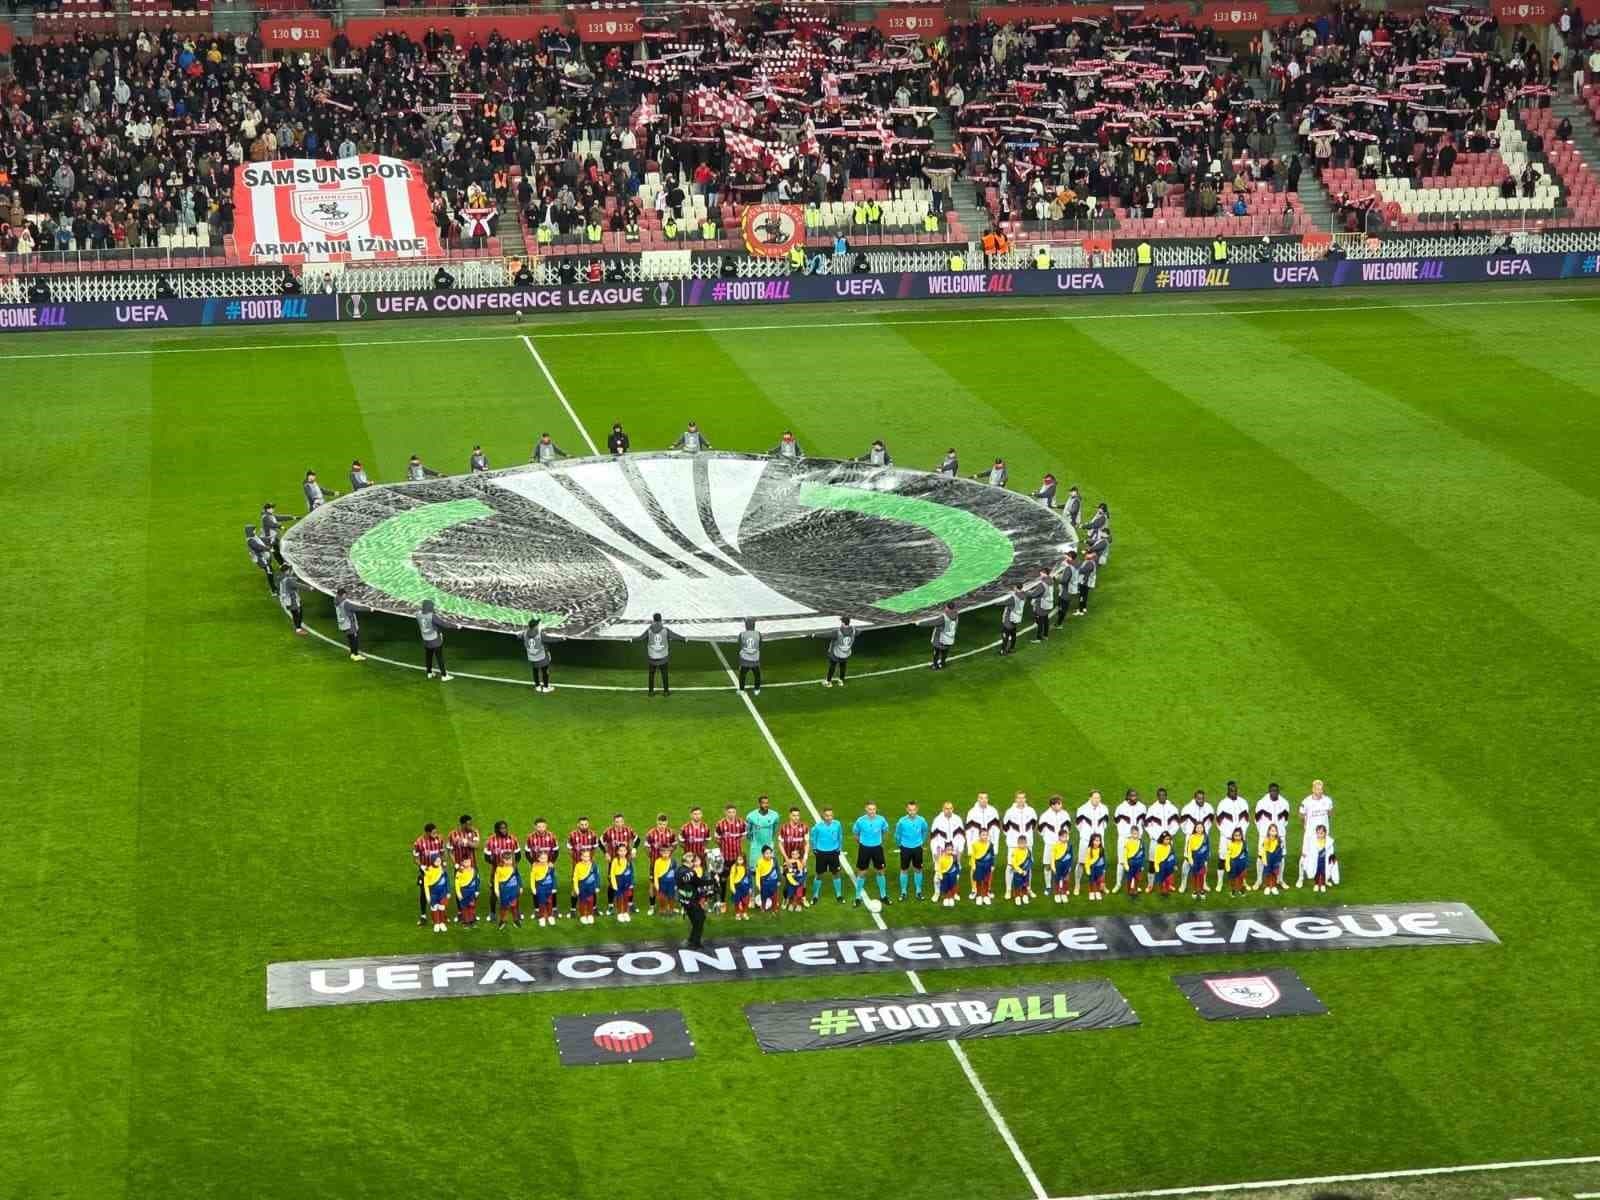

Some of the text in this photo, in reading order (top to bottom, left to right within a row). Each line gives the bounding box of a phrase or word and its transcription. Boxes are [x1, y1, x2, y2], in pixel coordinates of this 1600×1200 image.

[272, 29, 320, 39] 130 131
[588, 23, 634, 33] 131 132
[244, 164, 411, 187] SAMSUNSPOR
[1273, 266, 1319, 282] UEFA
[1362, 260, 1444, 280] WELCOME ALL
[1486, 259, 1532, 276] UEFA
[836, 279, 884, 296] UEFA
[929, 273, 1014, 294] WELCOME ALL
[1057, 274, 1104, 289] UEFA
[1156, 269, 1230, 288] #FOOTBALL
[376, 297, 429, 314] UEFA
[433, 289, 562, 312] CONFERENCE
[568, 287, 643, 306] LEAGUE
[712, 280, 791, 301] #FOOTBALL
[38, 306, 67, 326] ALL
[115, 305, 169, 322] UEFA
[226, 298, 309, 320] #FOOTBALL
[309, 959, 536, 994] UEFA
[557, 927, 1107, 978] CONFERENCE
[1129, 912, 1452, 947] LEAGUE
[809, 994, 1080, 1036] #FOOTBALL
